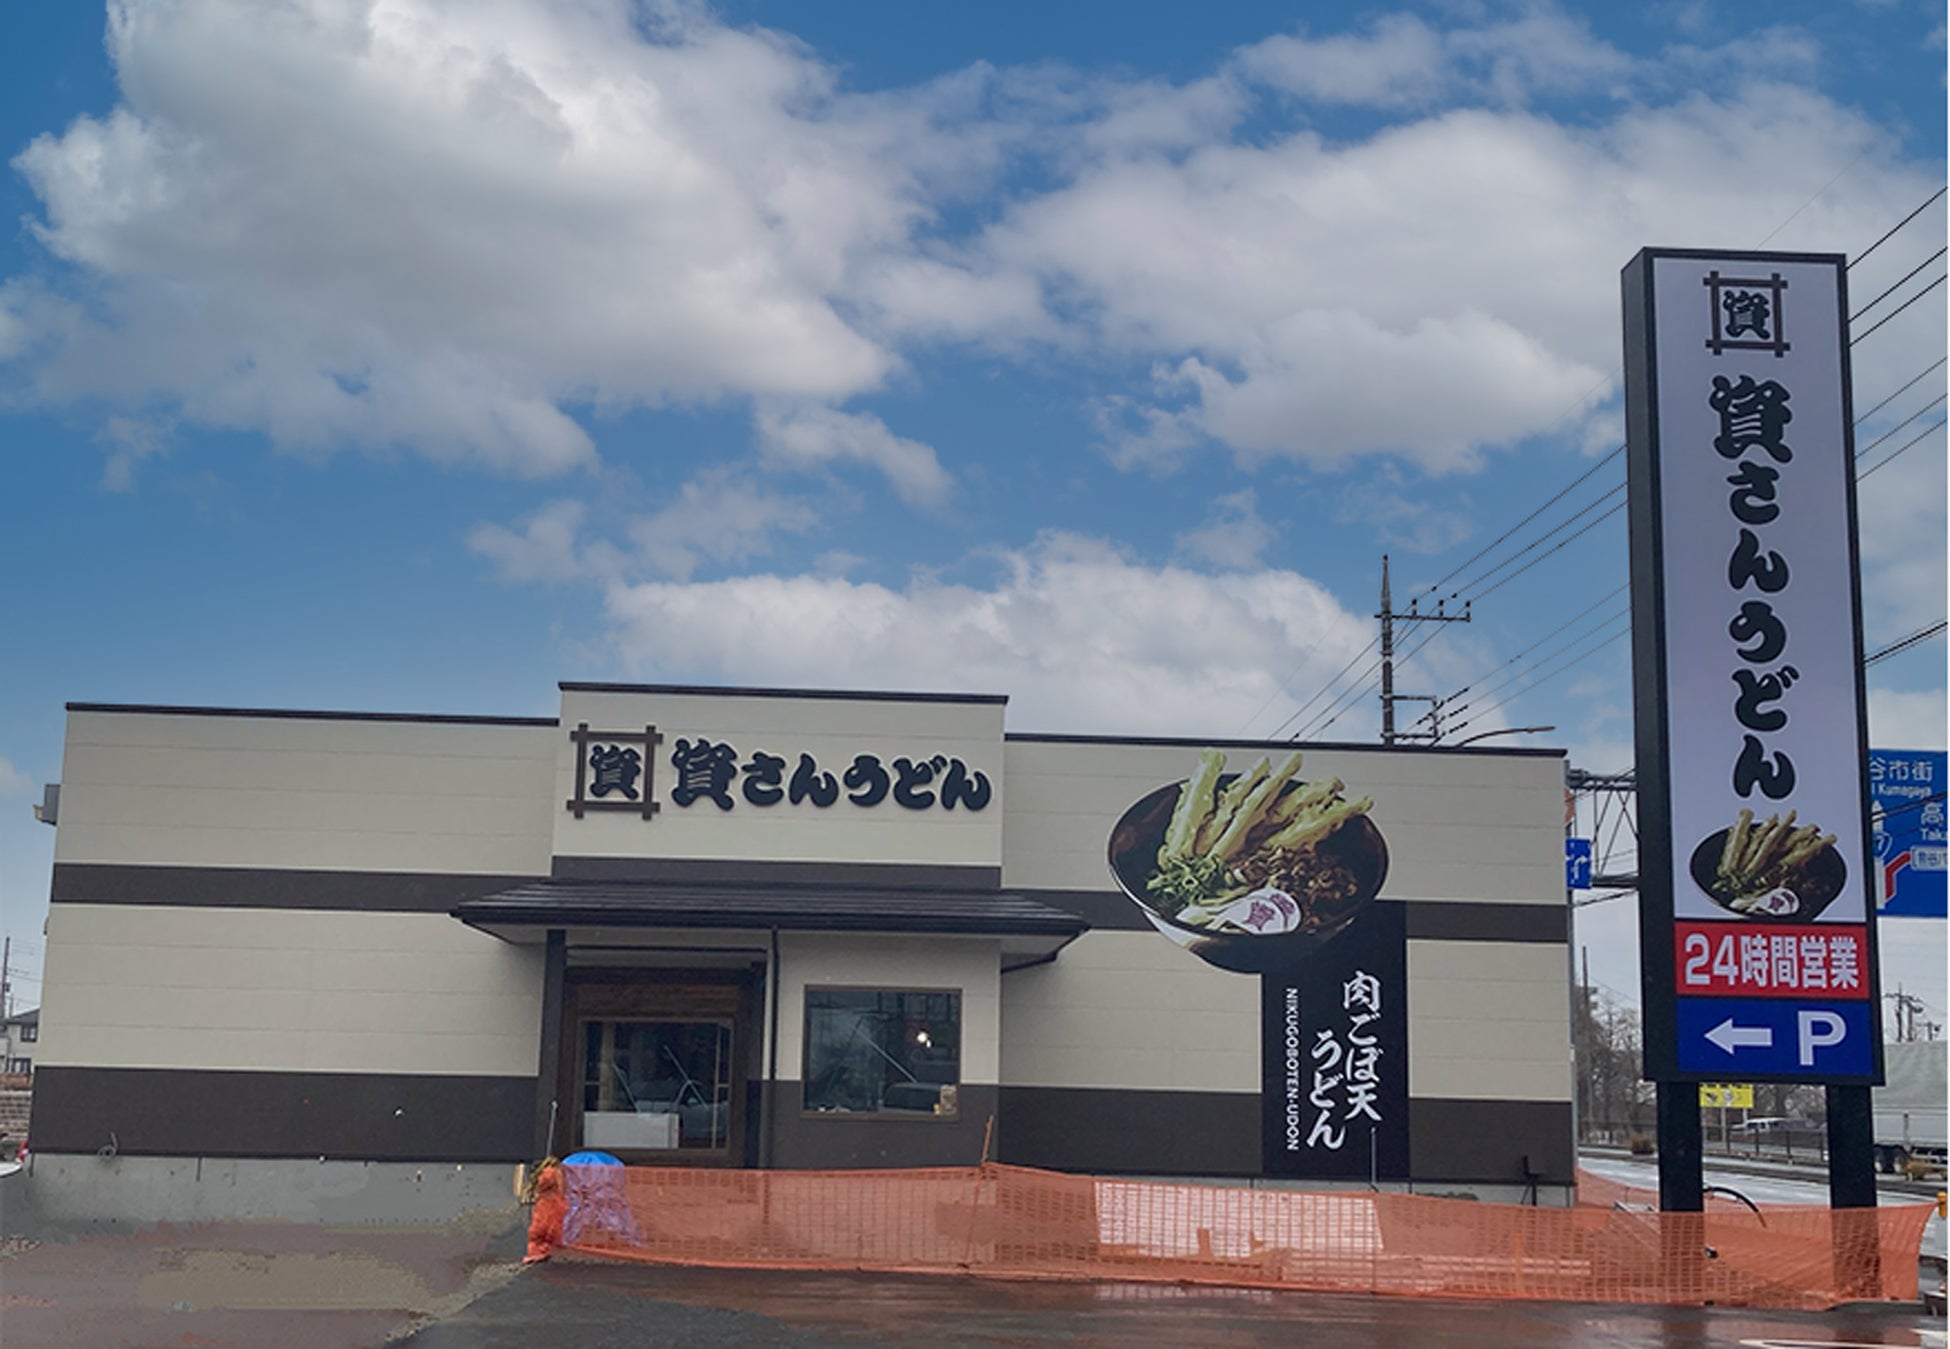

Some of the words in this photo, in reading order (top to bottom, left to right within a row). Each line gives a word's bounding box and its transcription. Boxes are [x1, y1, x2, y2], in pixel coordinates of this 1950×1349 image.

[1708, 375, 1799, 800] 資さんうどん
[671, 738, 992, 811] 資さんうどん
[1684, 933, 1859, 989] 24時間営業
[1343, 970, 1384, 1122] 肉ごぼ天
[1798, 1010, 1847, 1066] P
[1306, 1029, 1346, 1150] うどん
